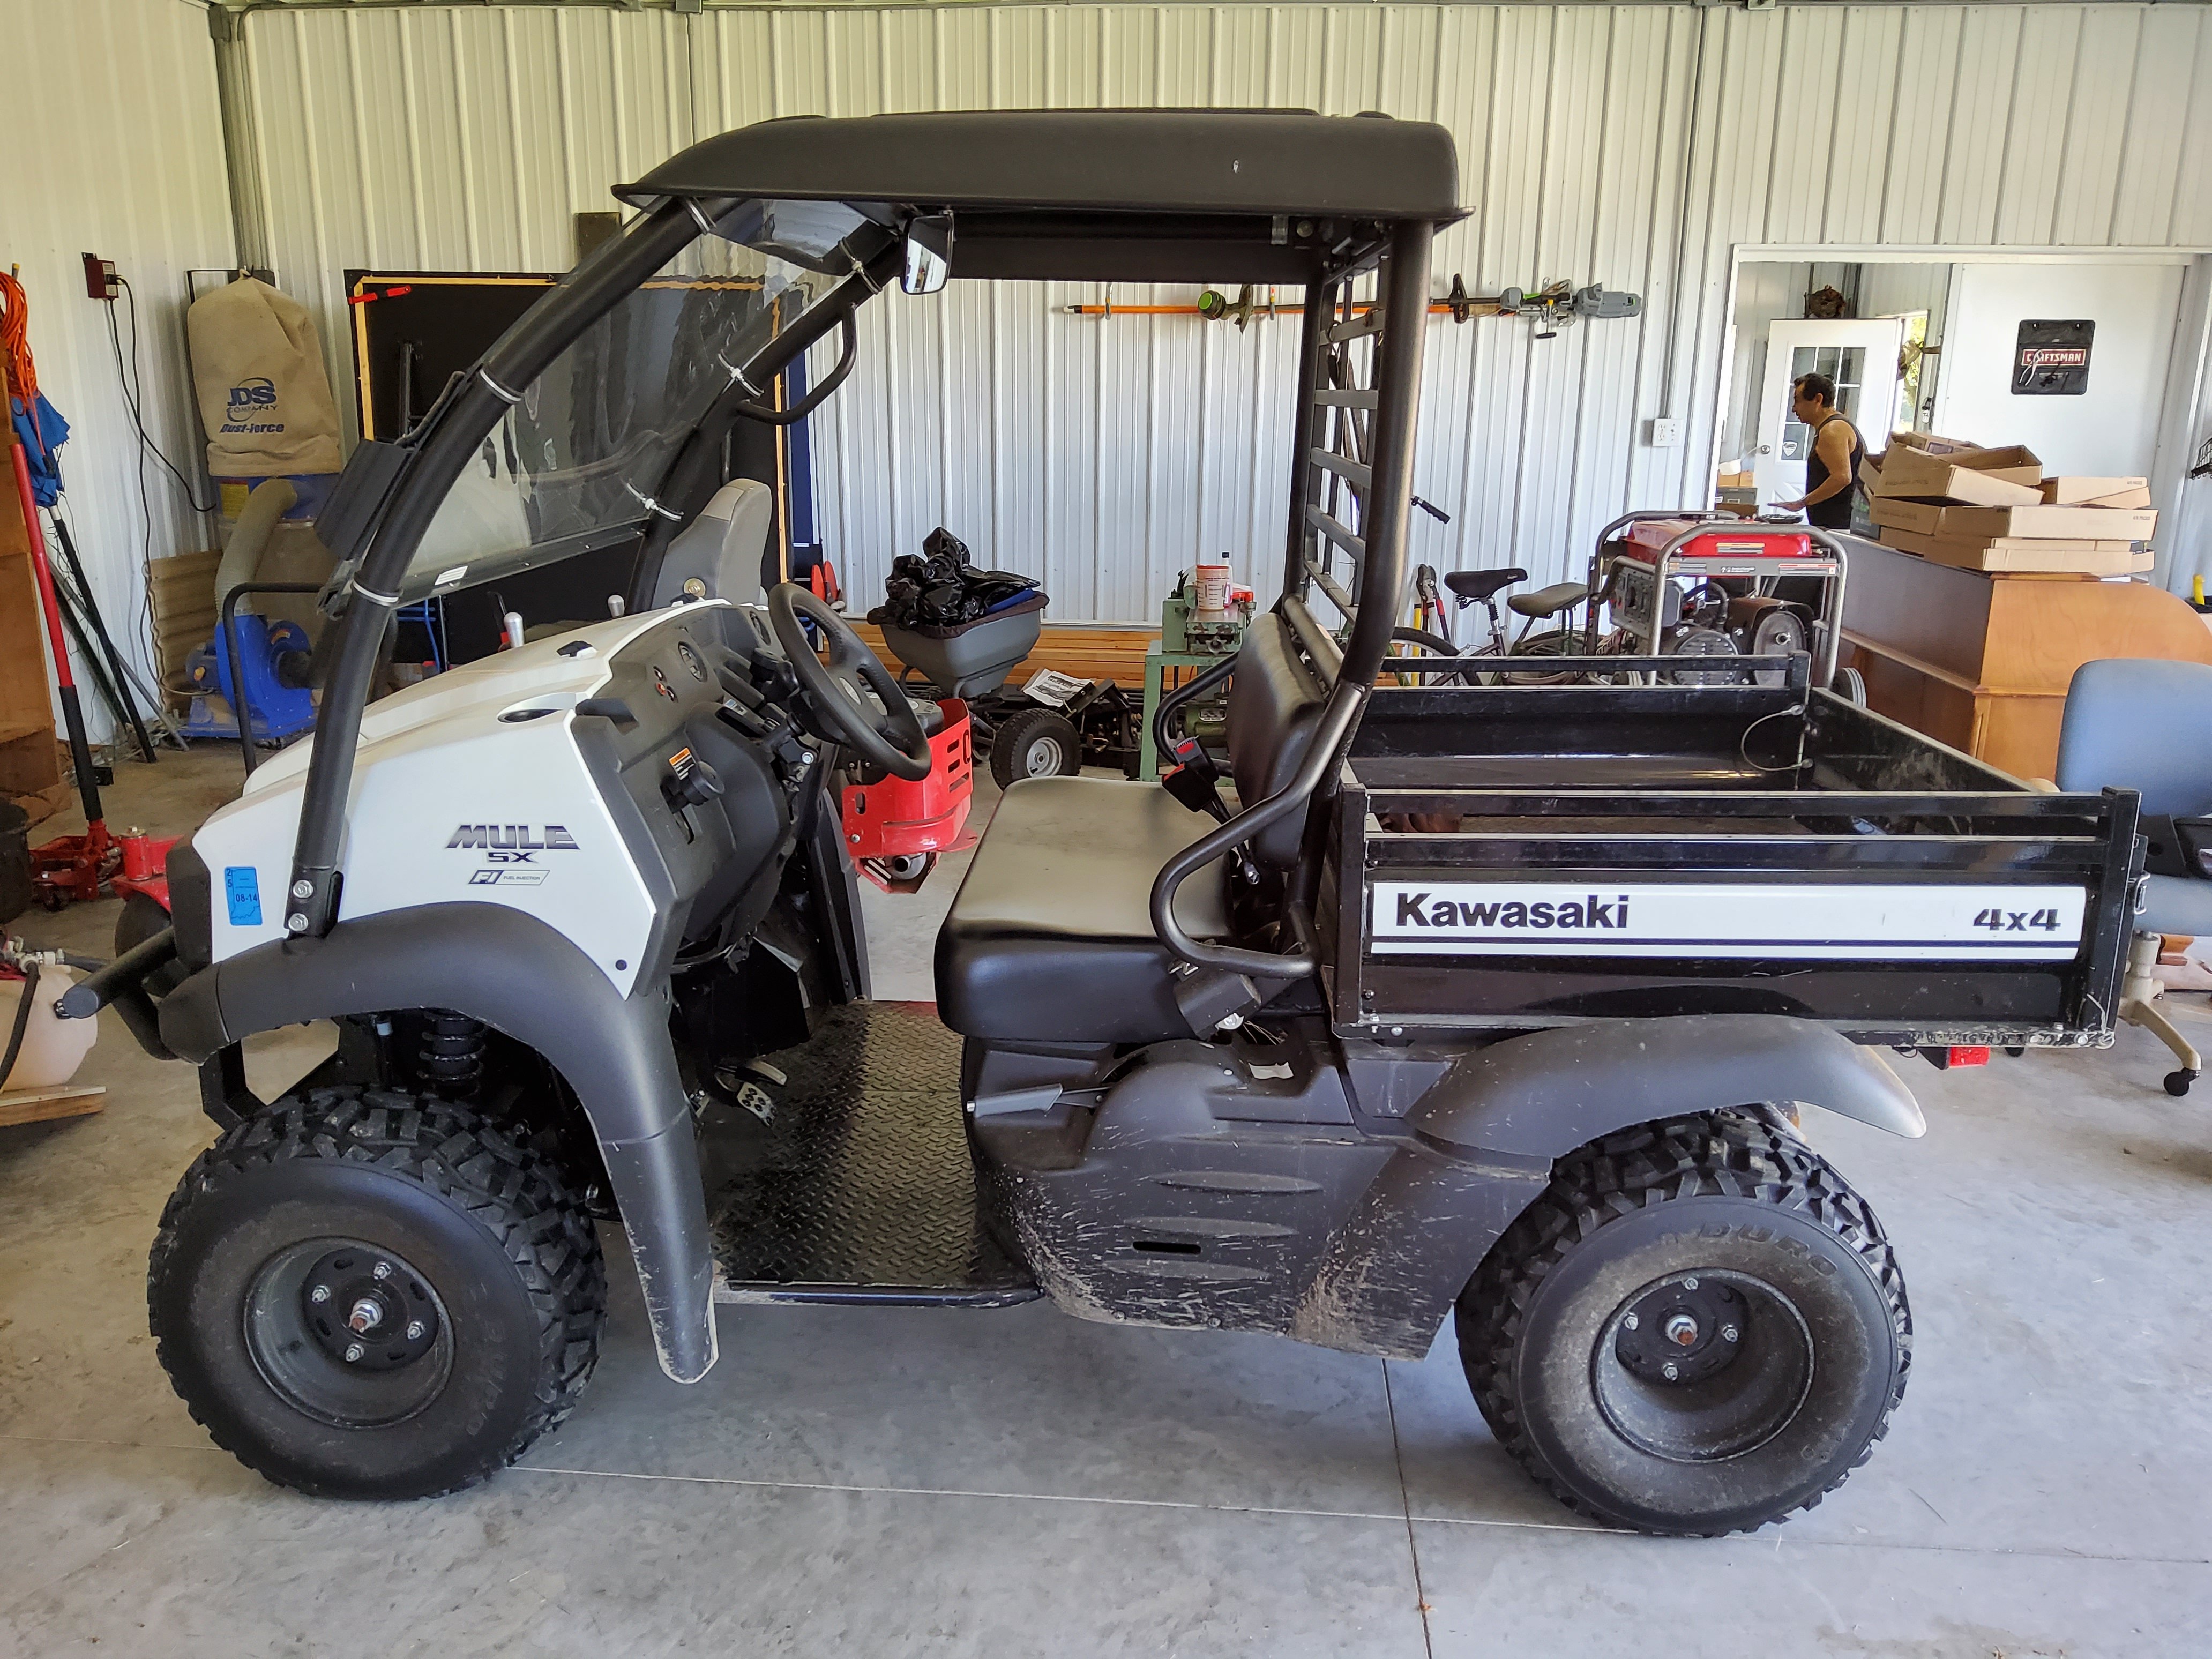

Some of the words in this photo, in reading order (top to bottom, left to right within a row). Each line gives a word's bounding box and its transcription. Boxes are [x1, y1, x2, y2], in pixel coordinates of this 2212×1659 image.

[2027, 353, 2081, 361] CAFTSMAN
[227, 386, 276, 406] JDS
[446, 825, 580, 850] MULE
[487, 851, 537, 863] SX
[472, 871, 500, 883] FI
[236, 893, 258, 902] 08-14
[1396, 893, 1629, 928] Kawasaki
[1972, 909, 2061, 931] 4x4
[1698, 1221, 1838, 1277] DURO
